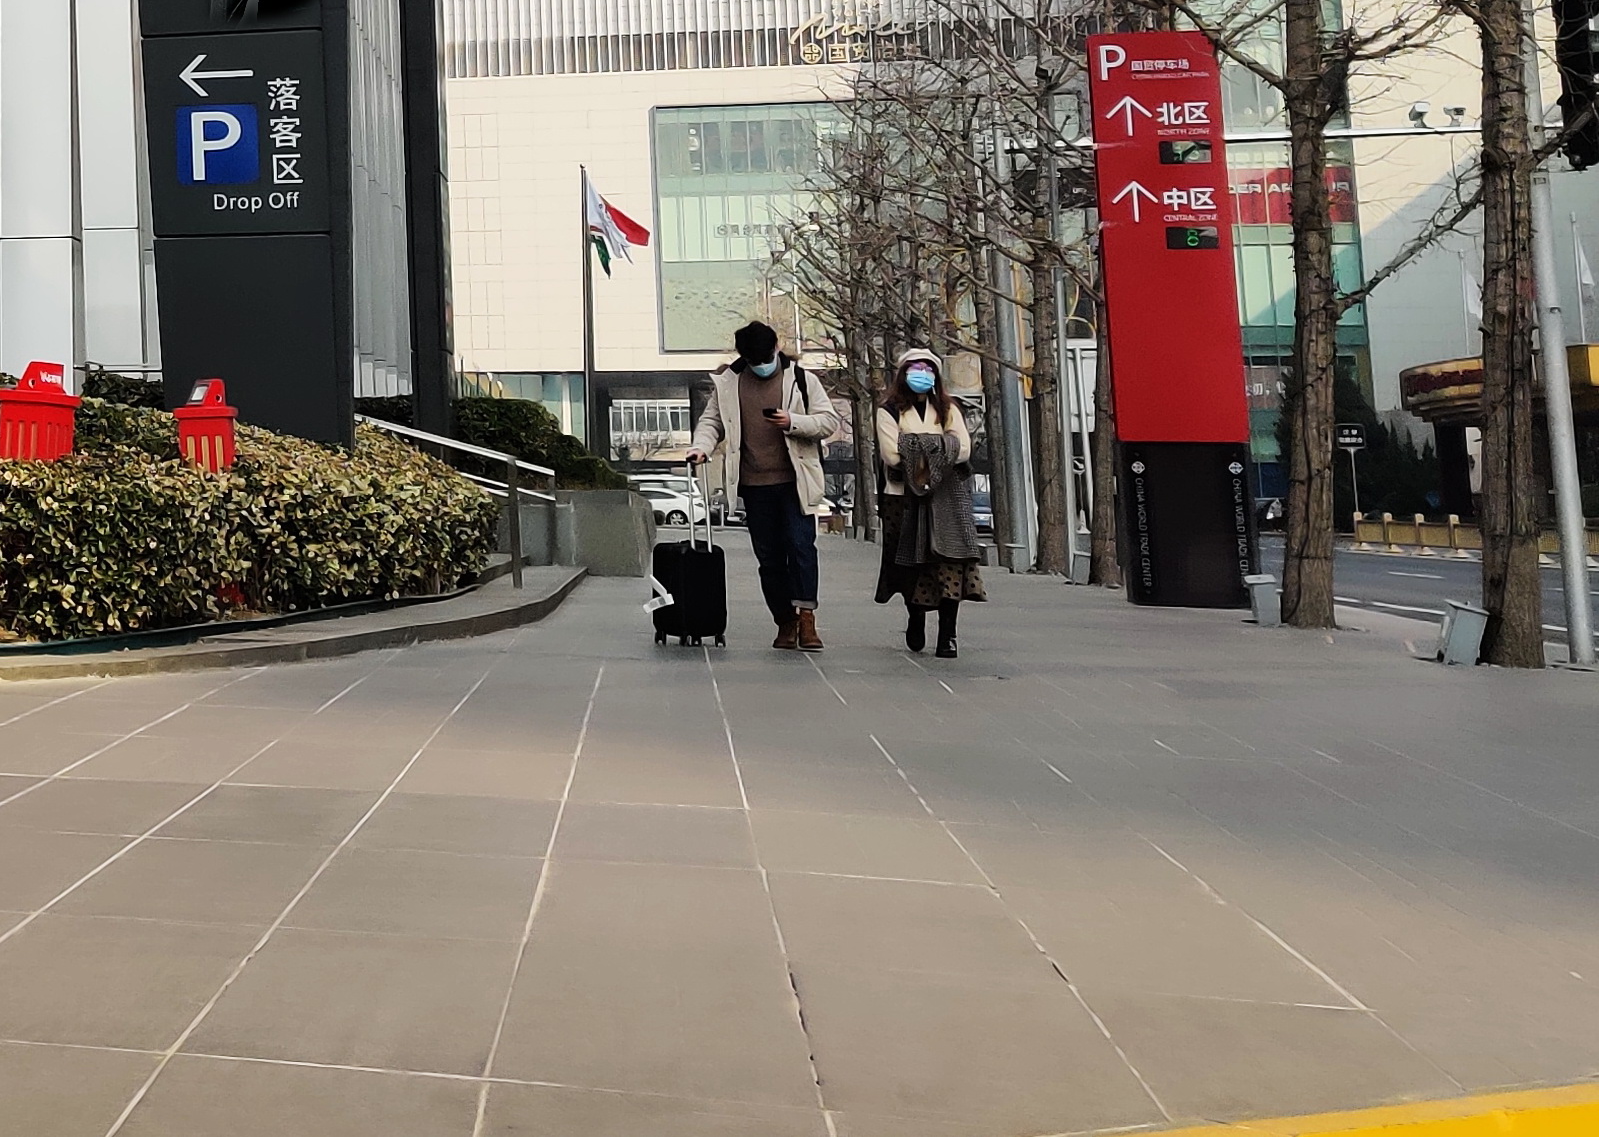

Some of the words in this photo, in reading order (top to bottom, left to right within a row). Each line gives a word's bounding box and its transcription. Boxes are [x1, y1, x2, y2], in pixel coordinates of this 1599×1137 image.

[1099, 45, 1126, 81] P
[1156, 101, 1211, 126] 北区
[190, 111, 242, 181] P
[267, 77, 303, 185] 落客区
[213, 193, 263, 213] Drop
[268, 192, 300, 209] Off
[1163, 187, 1217, 211] 中区
